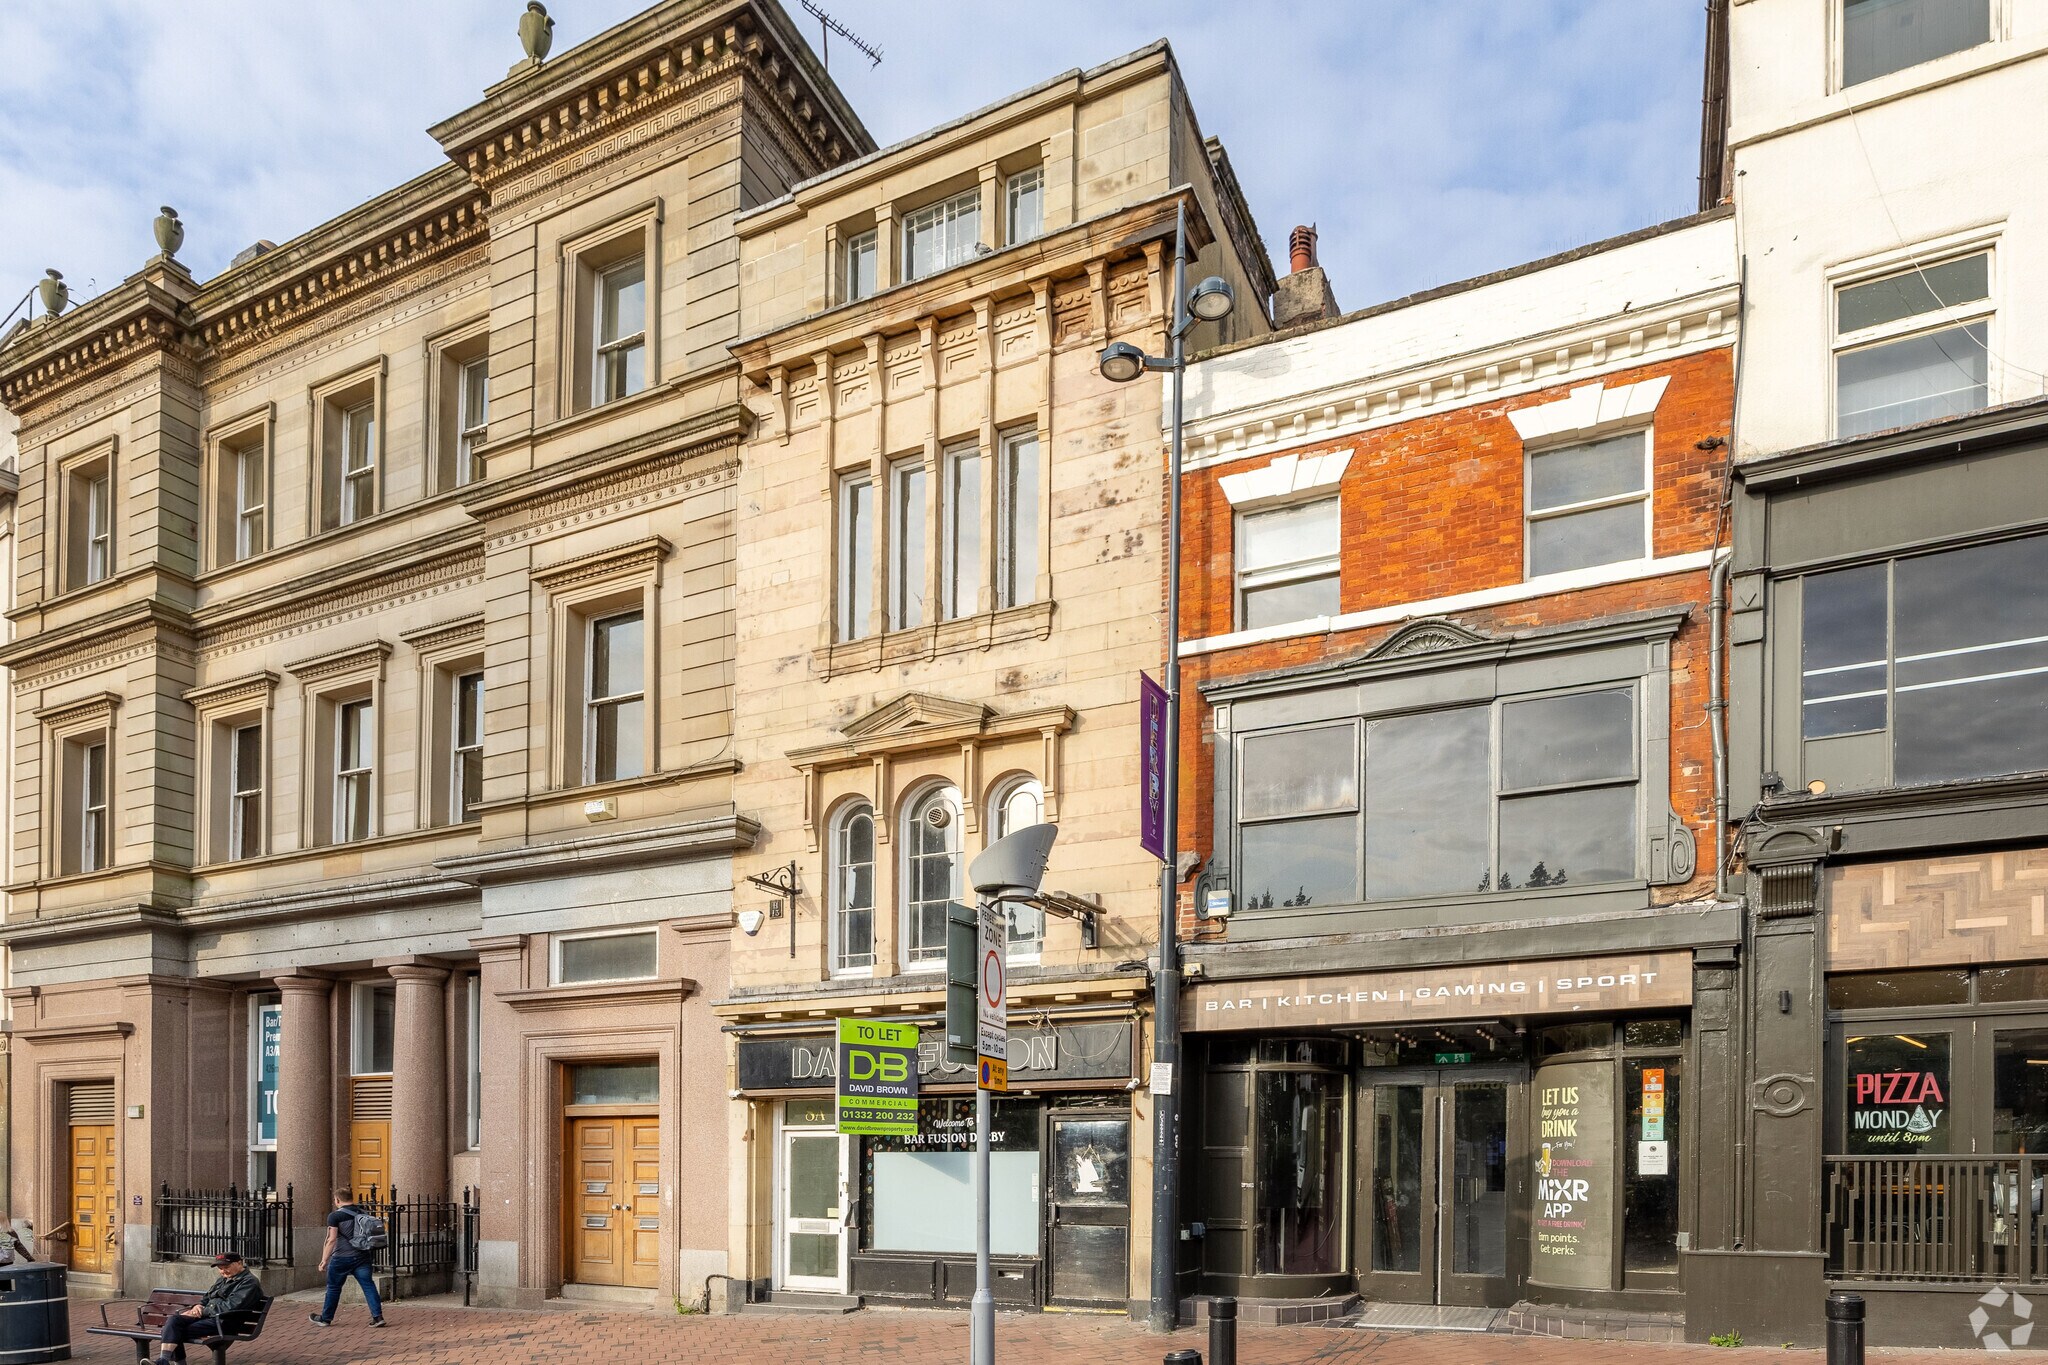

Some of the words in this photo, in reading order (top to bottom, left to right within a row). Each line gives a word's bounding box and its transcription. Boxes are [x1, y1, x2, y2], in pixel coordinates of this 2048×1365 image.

[985, 925, 1001, 948] ZONE
[1206, 999, 1252, 1011] BAR
[1277, 990, 1388, 1007] KITCHEN
[1415, 981, 1526, 998] GAMING
[1556, 972, 1657, 990] SPORT
[857, 1026, 874, 1040] TO
[879, 1028, 902, 1041] LET
[981, 1027, 994, 1040] Except
[994, 1033, 1006, 1043] cycles
[792, 1047, 837, 1079] BA
[849, 1084, 874, 1093] DAVID
[876, 1086, 908, 1094] BROWN
[1856, 1072, 1944, 1104] PIZZA
[849, 1098, 908, 1107] COMMERCIAL
[1542, 1088, 1559, 1106] LET
[1562, 1087, 1579, 1105] US
[842, 1110, 873, 1119] 01332
[875, 1111, 894, 1120] 200
[896, 1112, 915, 1121] 232
[1552, 1107, 1569, 1120] you
[1571, 1107, 1579, 1116] a
[933, 1119, 964, 1129] Welcome
[966, 1117, 974, 1128] To
[1541, 1119, 1578, 1138] DRINK
[904, 1134, 925, 1144] BAR
[927, 1133, 966, 1144] FUSION
[969, 1131, 1005, 1142] DBY
[1868, 1131, 1901, 1143] until
[1902, 1132, 1932, 1144] 8pm
[1552, 1159, 1593, 1168] DOWNLOAD
[1552, 1168, 1569, 1177] THE
[1544, 1203, 1573, 1218] APP
[1552, 1220, 1563, 1228] FREE
[1550, 1232, 1580, 1243] points.
[1540, 1244, 1551, 1254] Get
[1552, 1245, 1577, 1255] perks.
